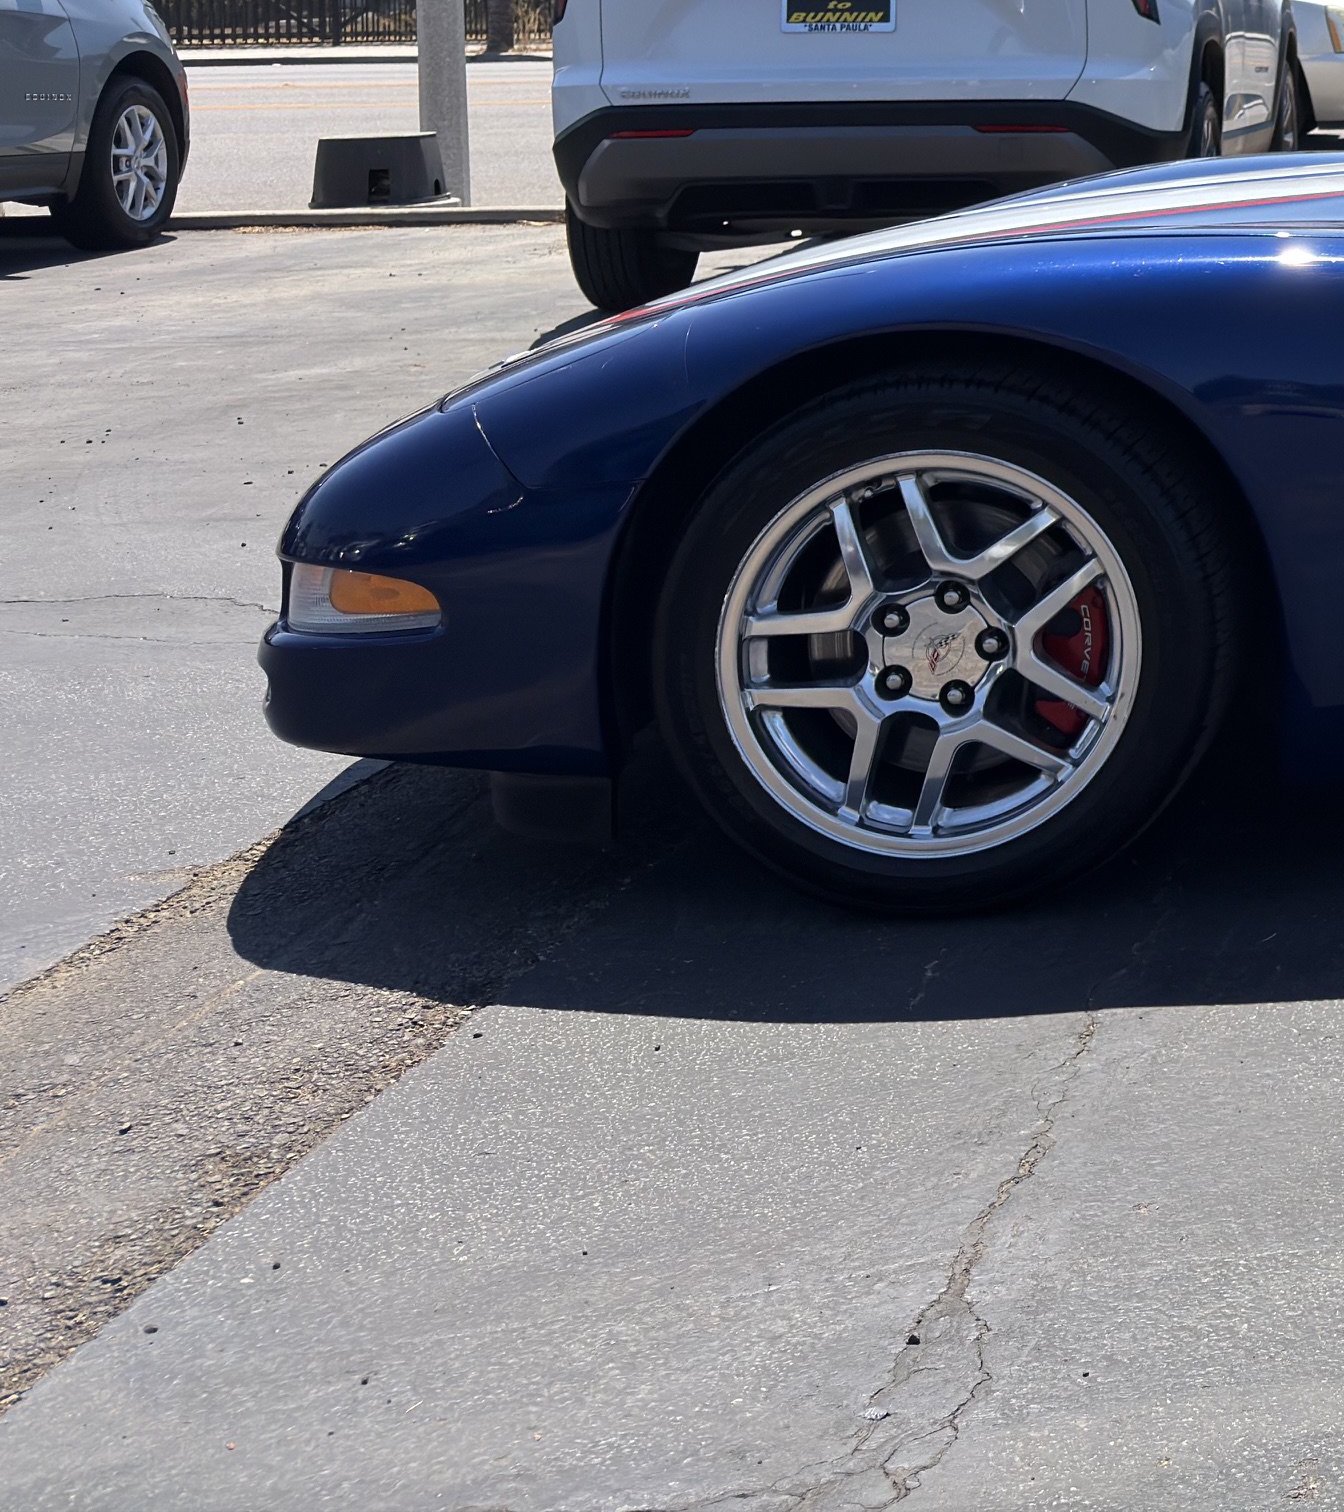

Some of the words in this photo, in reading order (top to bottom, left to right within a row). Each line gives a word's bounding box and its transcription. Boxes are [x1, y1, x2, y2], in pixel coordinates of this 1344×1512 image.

[827, 1, 852, 9] to
[788, 12, 883, 23] BUNNIN
[25, 93, 72, 101] EQUINOX
